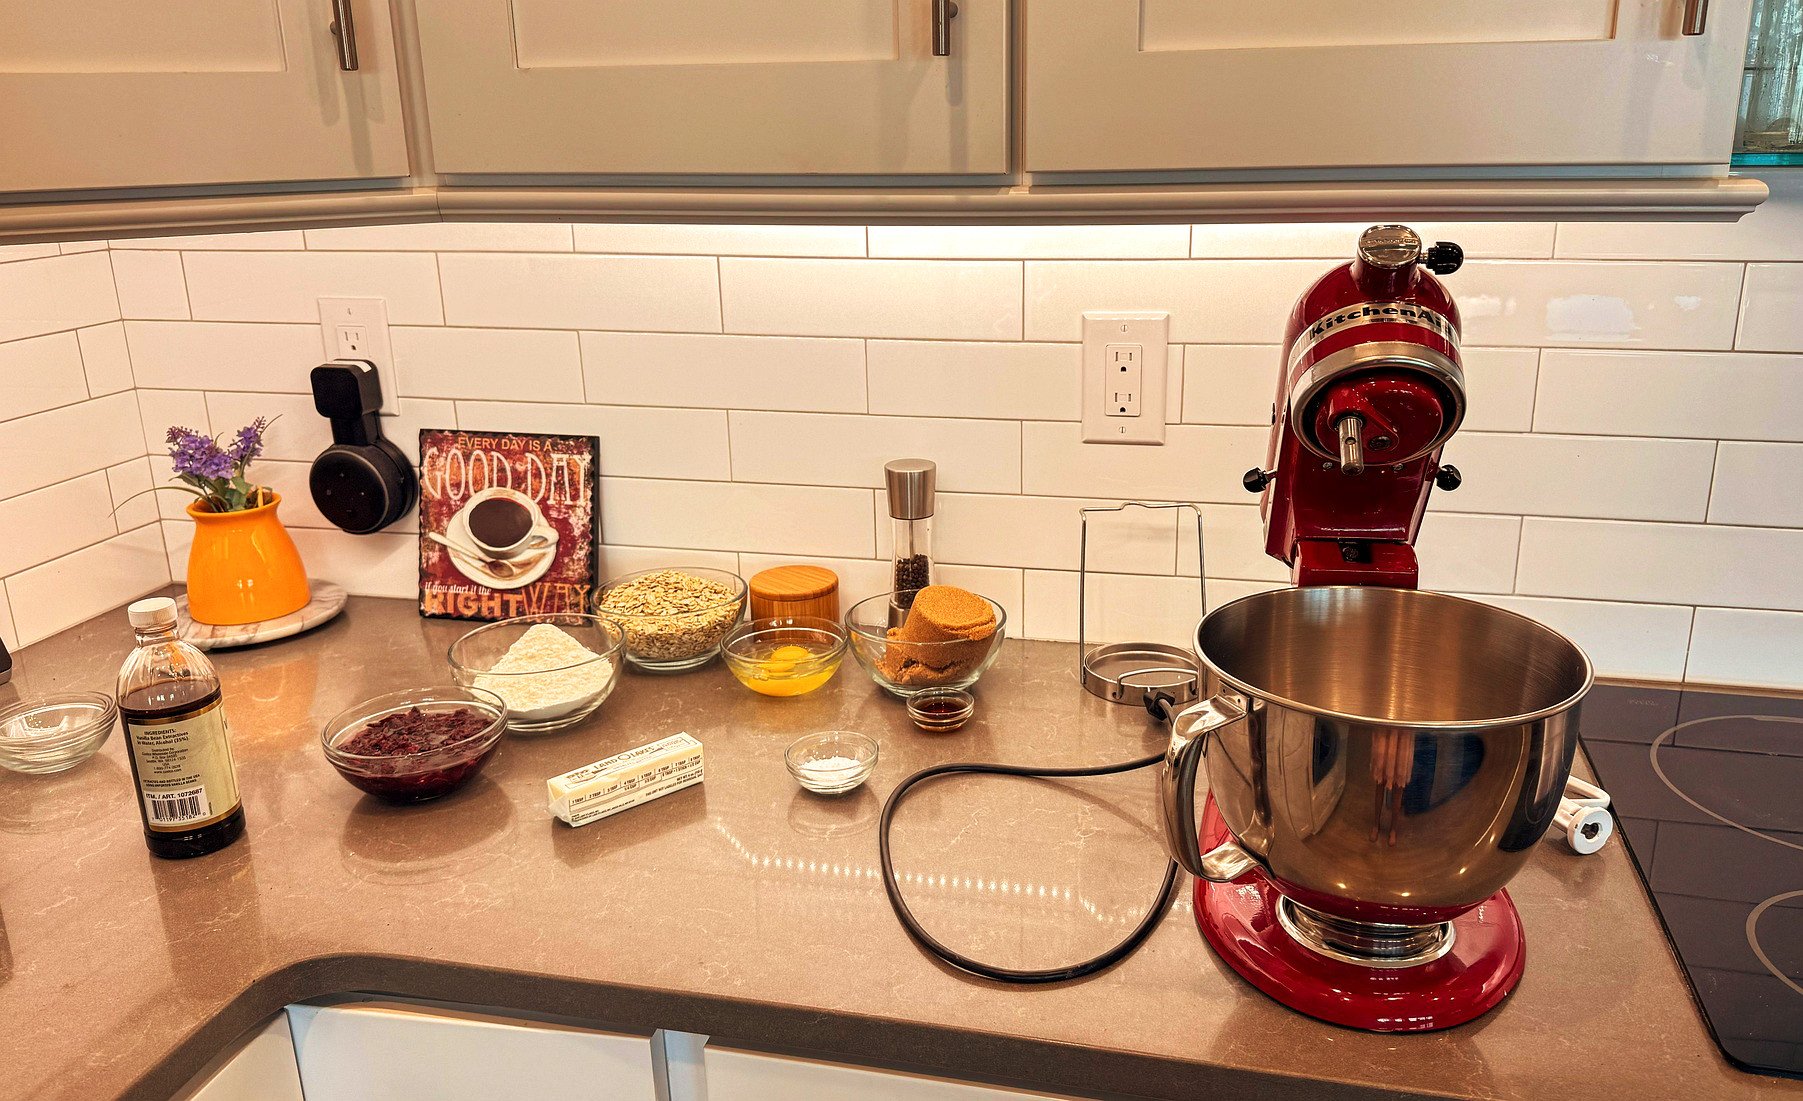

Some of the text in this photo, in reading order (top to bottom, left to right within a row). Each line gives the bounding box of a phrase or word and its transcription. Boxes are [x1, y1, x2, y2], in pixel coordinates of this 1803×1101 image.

[458, 437, 552, 452] EVERY DAY IS A
[424, 448, 592, 505] GOOD DAY
[432, 583, 448, 595] you
[449, 584, 468, 594] start
[470, 584, 476, 594] it
[478, 585, 491, 595] the
[424, 582, 590, 624] RIGHT WAY
[594, 759, 618, 770] LAND
